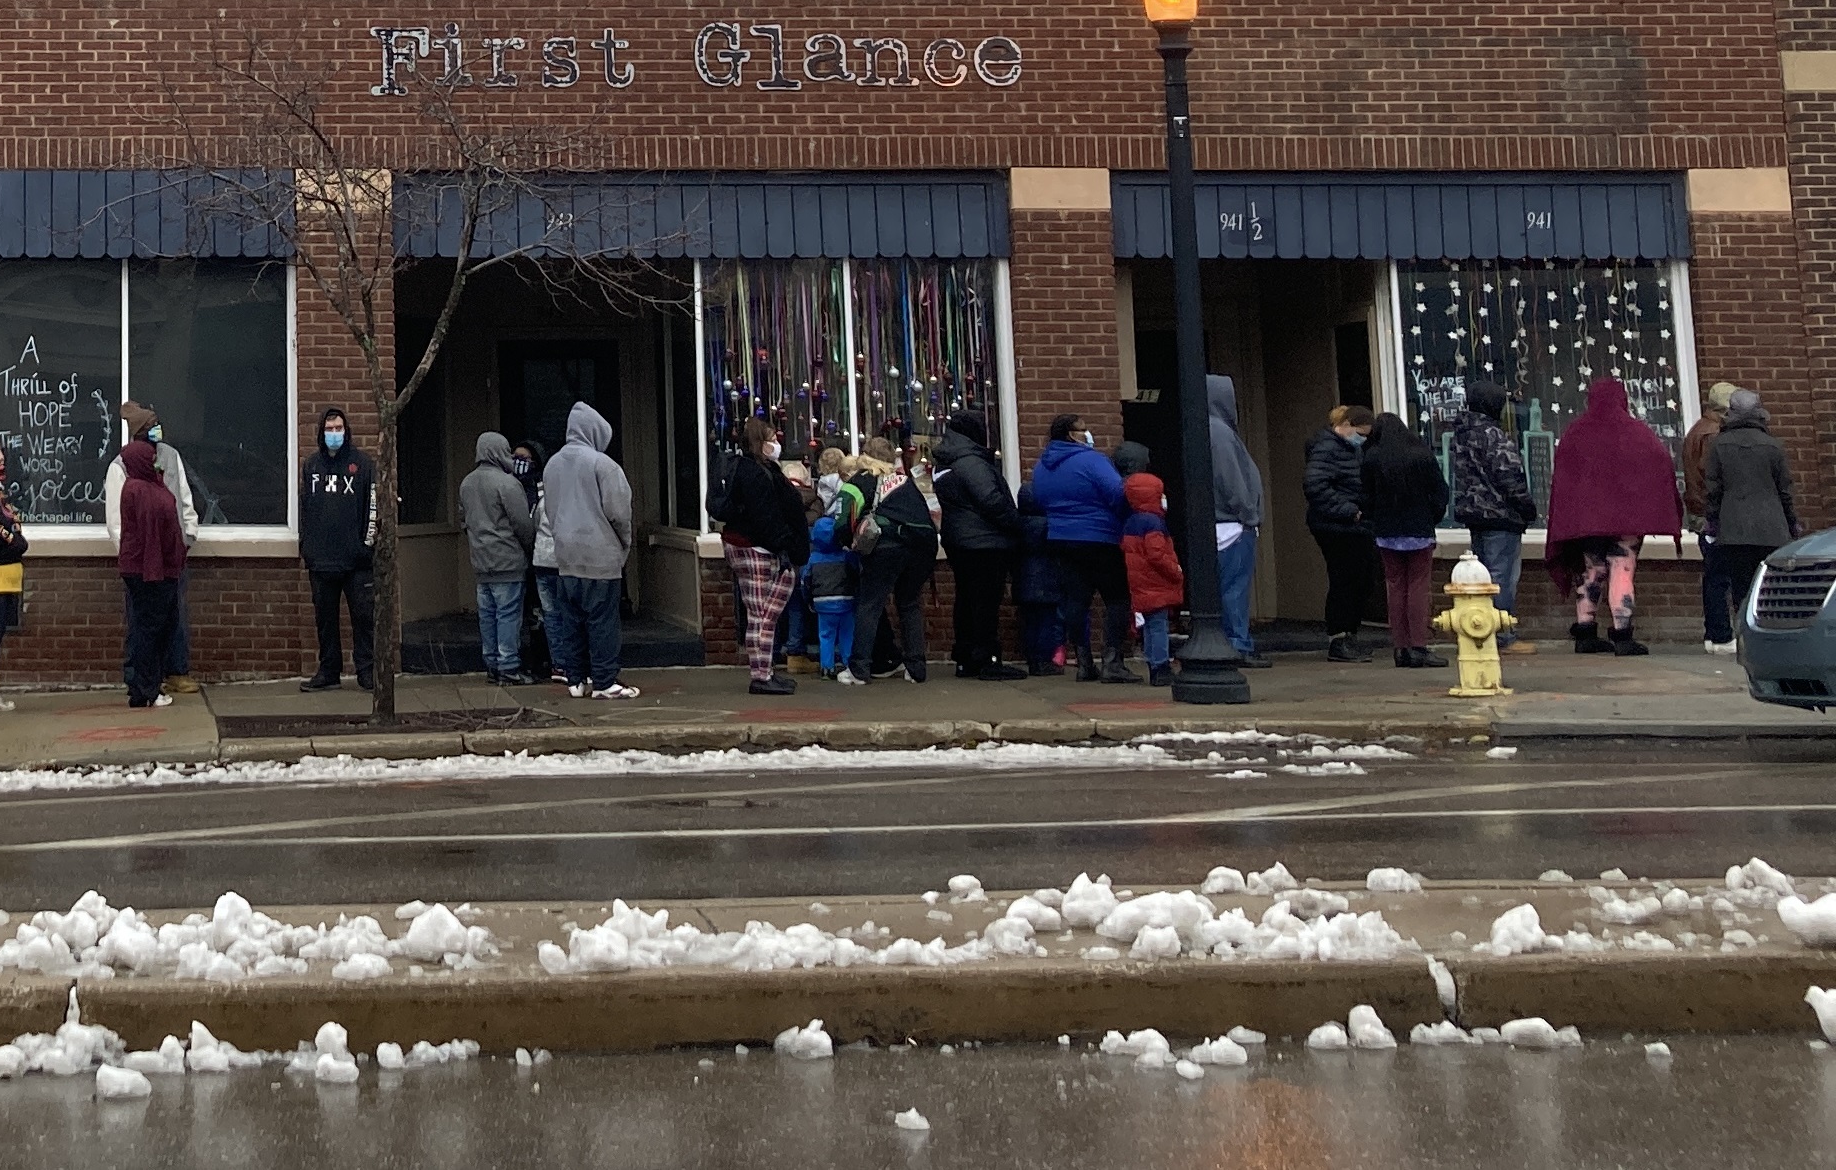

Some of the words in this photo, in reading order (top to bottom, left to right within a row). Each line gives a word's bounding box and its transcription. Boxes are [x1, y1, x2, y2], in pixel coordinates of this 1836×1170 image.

[370, 23, 635, 96] First
[694, 22, 1022, 91] Glance
[1220, 213, 1242, 230] 941
[1527, 211, 1551, 229] 941
[19, 335, 40, 364] A
[19, 400, 72, 428] HOPE
[27, 431, 84, 456] WEARY
[19, 456, 64, 474] WORLD
[16, 511, 93, 524] thechapel.life
